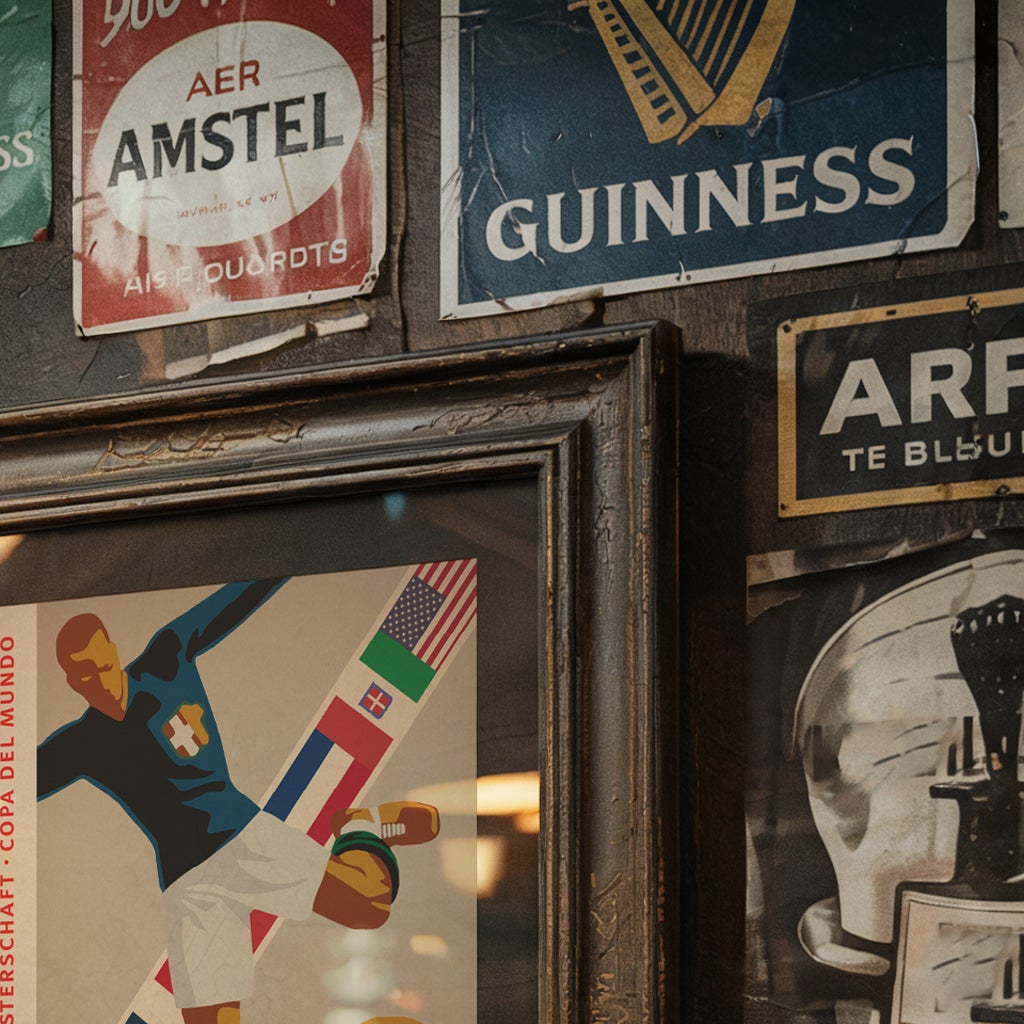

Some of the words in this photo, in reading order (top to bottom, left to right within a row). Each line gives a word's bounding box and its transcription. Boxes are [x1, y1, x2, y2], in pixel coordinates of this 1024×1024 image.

[186, 60, 261, 101] AER
[107, 92, 344, 188] AMSTEL
[485, 135, 916, 262] GUINNESS
[842, 445, 886, 472] TE
[0, 636, 15, 727] MUNDO
[0, 737, 15, 780] DEL
[0, 790, 15, 852] COPA
